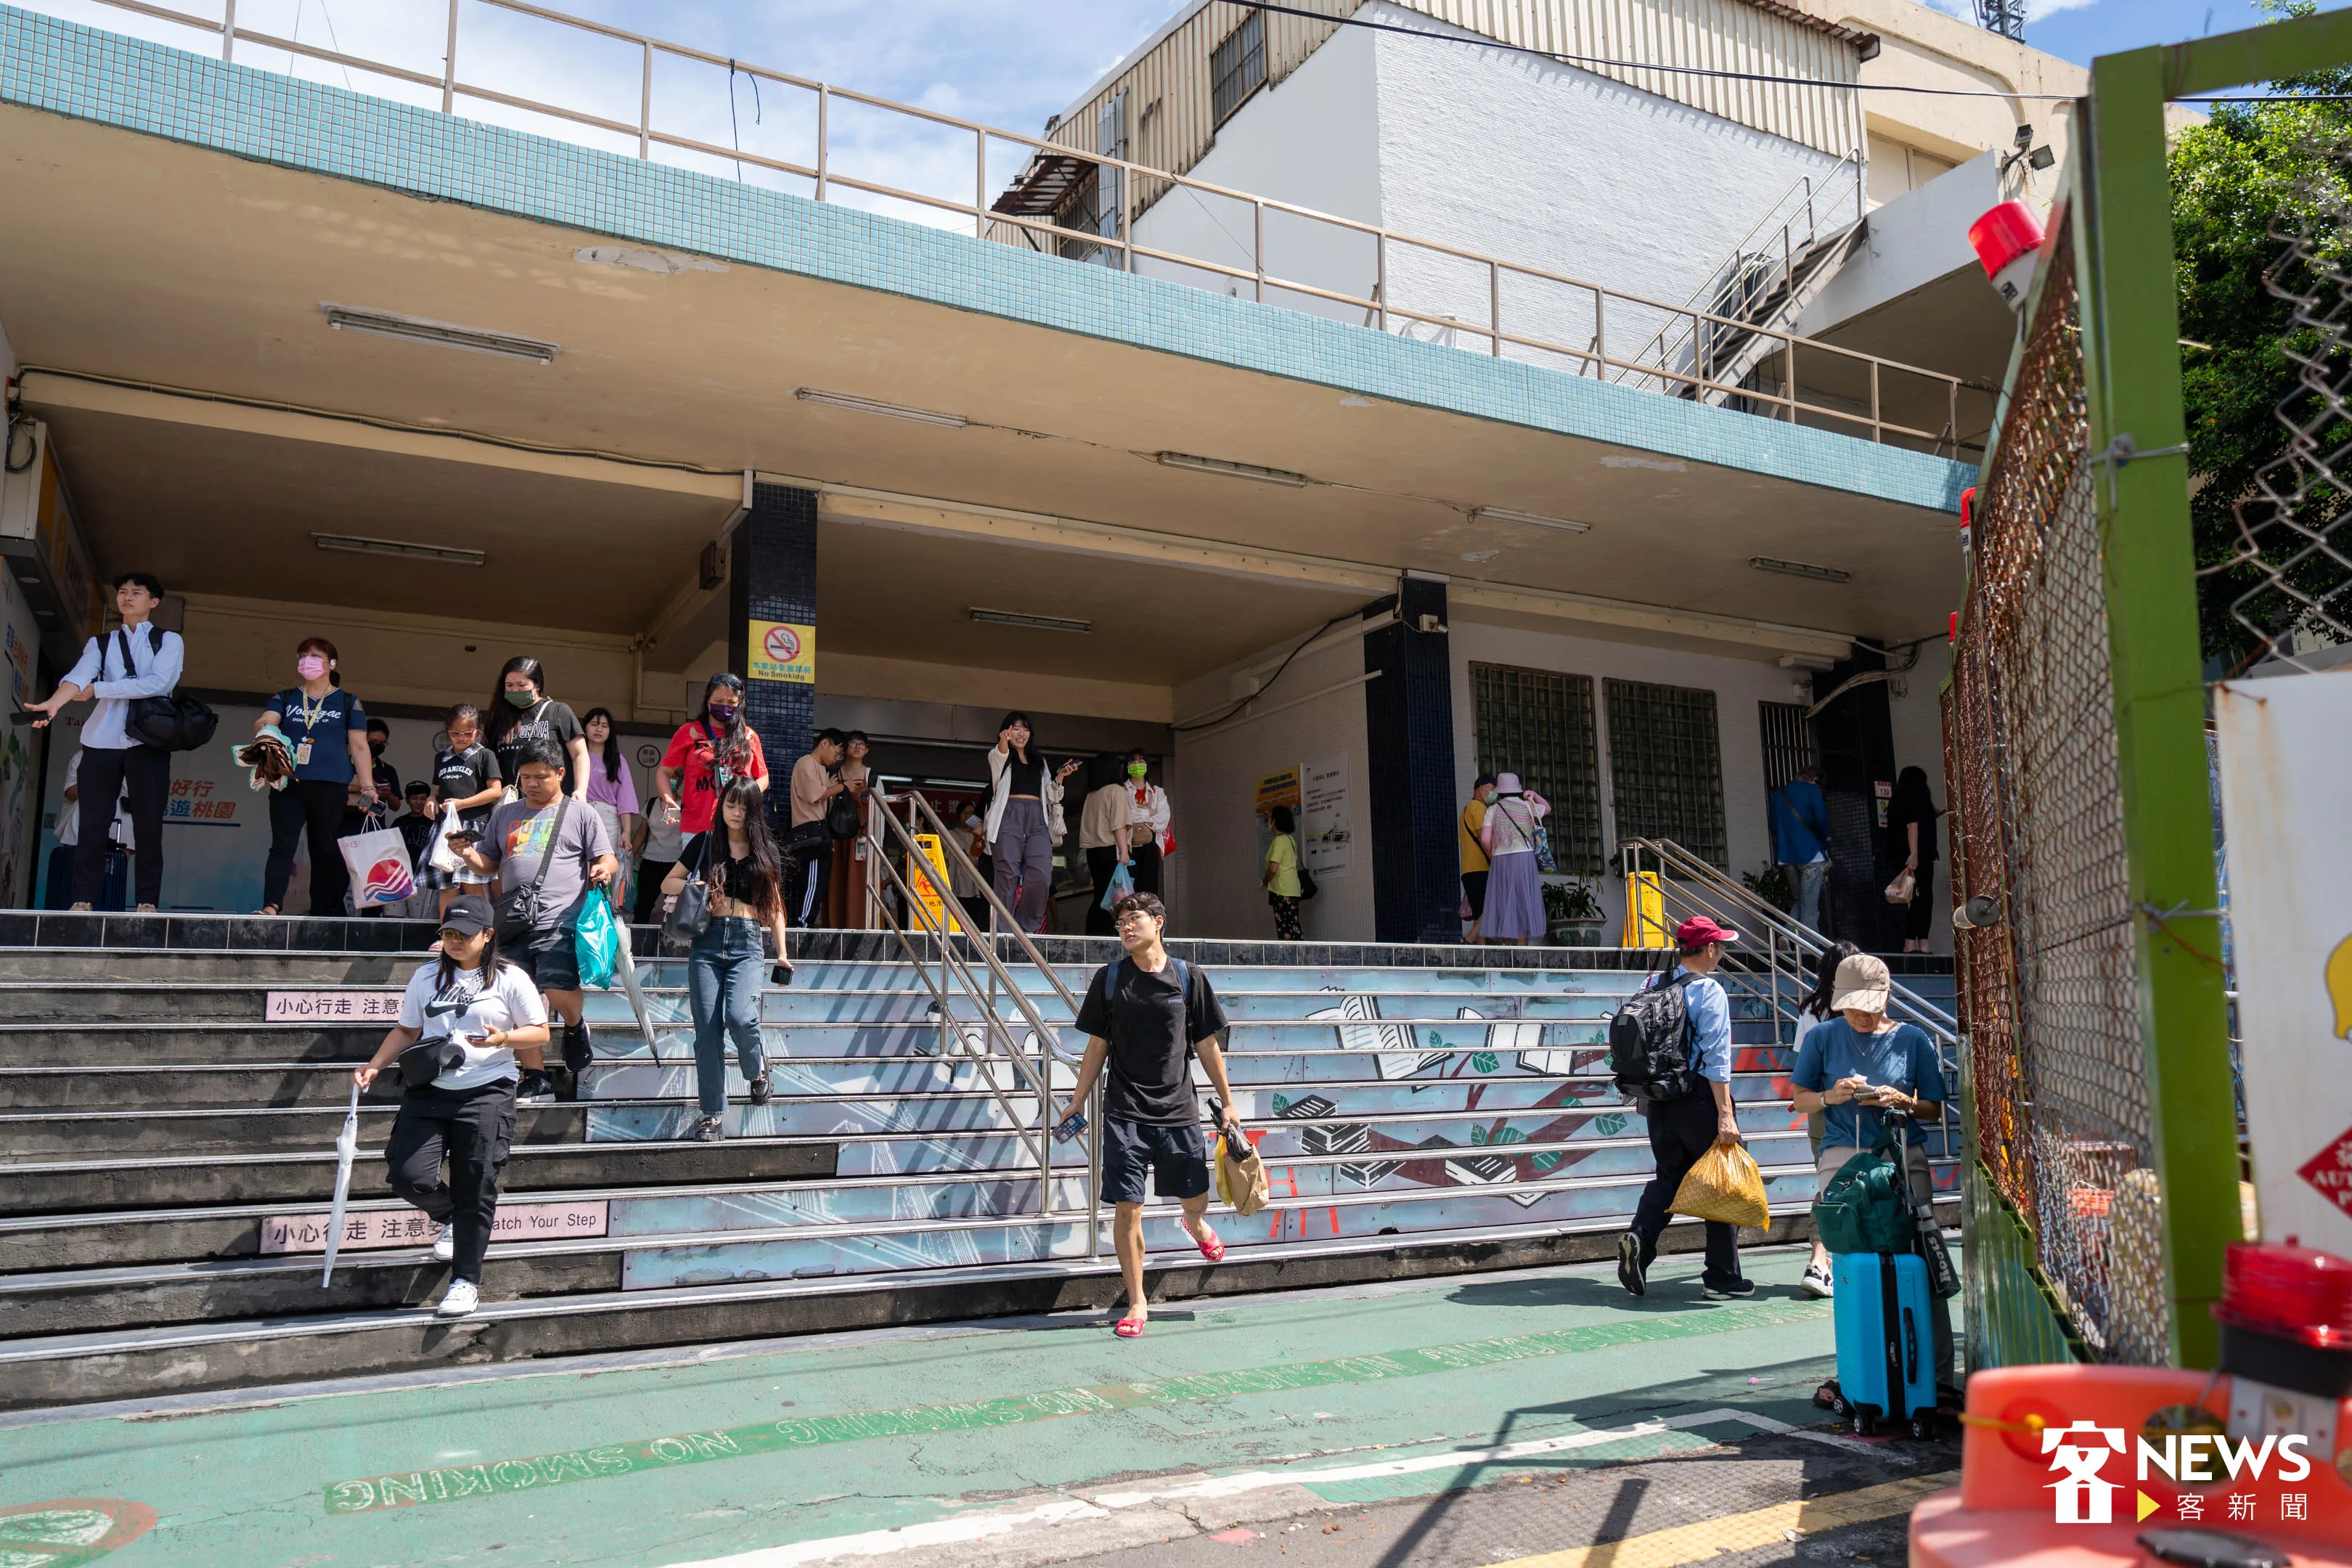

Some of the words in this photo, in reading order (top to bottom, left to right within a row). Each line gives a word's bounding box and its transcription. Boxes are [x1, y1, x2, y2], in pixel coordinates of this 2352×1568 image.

[771, 671, 804, 681] Smoking
[447, 765, 473, 776] ANGELES
[169, 779, 215, 798] 好行
[277, 997, 352, 1015] 小心行走
[362, 998, 403, 1015] 注意
[492, 1216, 521, 1230] atch
[530, 1214, 559, 1228] Your
[567, 1213, 597, 1228] Step
[1928, 1236, 1951, 1283] Roots
[1026, 1387, 1114, 1415] NO
[775, 1397, 1024, 1444] SMOKING
[650, 1430, 742, 1463] NO
[334, 1447, 632, 1510] SMOKING
